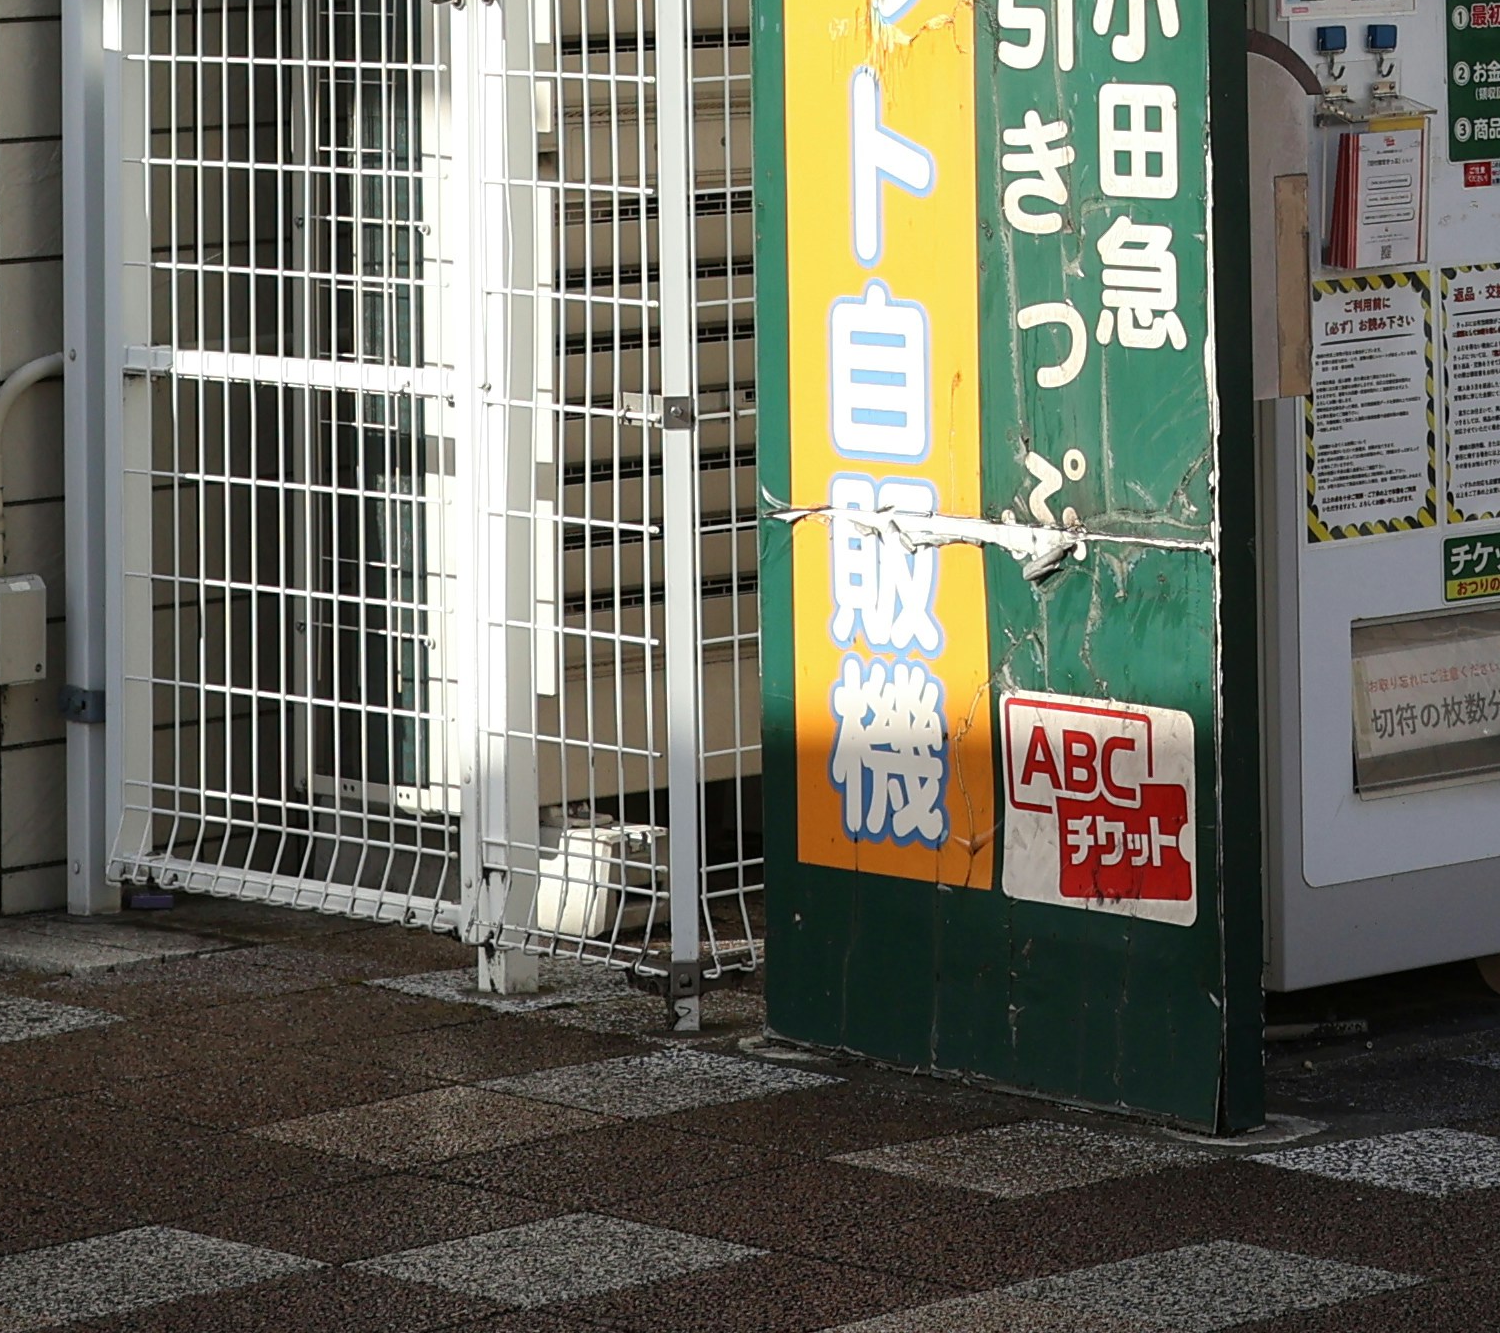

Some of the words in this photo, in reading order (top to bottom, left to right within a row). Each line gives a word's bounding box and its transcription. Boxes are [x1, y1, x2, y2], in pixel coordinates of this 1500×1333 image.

[1343, 296, 1392, 314] ご利用前に
[1358, 314, 1416, 332] お読み下さい
[1020, 723, 1148, 797] ABC
[1066, 811, 1182, 873] チケット
